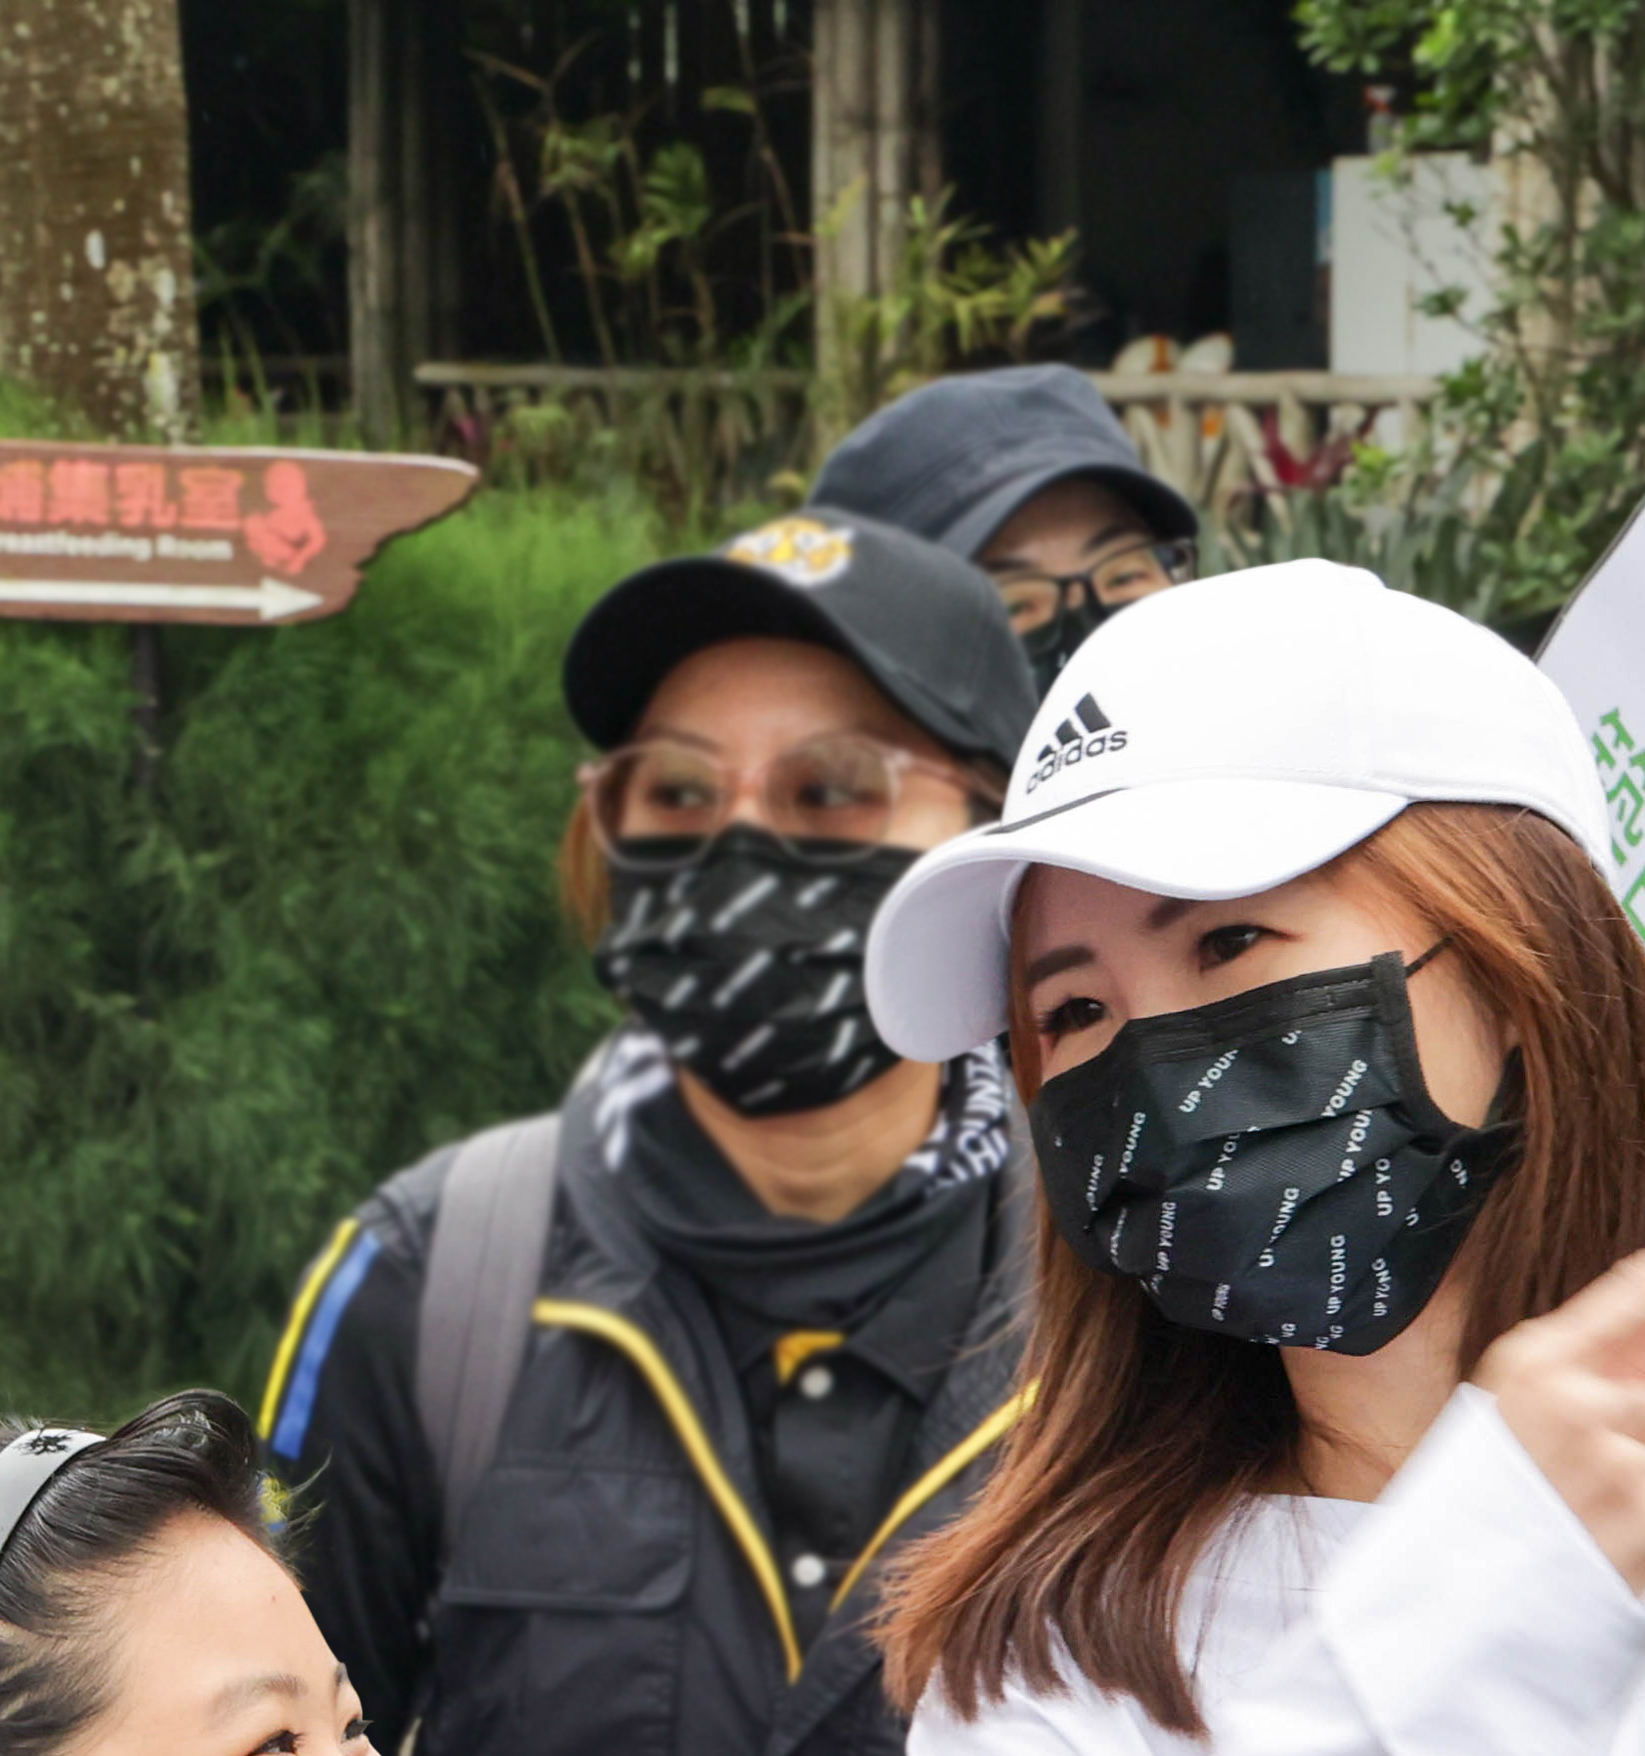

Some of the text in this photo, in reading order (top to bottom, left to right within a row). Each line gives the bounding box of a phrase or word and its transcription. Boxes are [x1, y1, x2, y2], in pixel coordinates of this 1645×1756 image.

[156, 533, 233, 560] Room
[1026, 730, 1128, 795] adidas
[1179, 1090, 1201, 1113] UP
[1321, 1059, 1368, 1117] YOUNG
[1346, 1109, 1374, 1153] YOU
[1119, 1112, 1146, 1178] YOUNG
[1205, 1166, 1225, 1191] UP
[1376, 1190, 1394, 1217] UP
[1156, 1202, 1176, 1271] UP YOUNG
[1258, 1248, 1275, 1268] U
[1330, 1234, 1346, 1294] YOUNG
[1326, 1296, 1342, 1315] UP
[1372, 1301, 1388, 1317] UP
